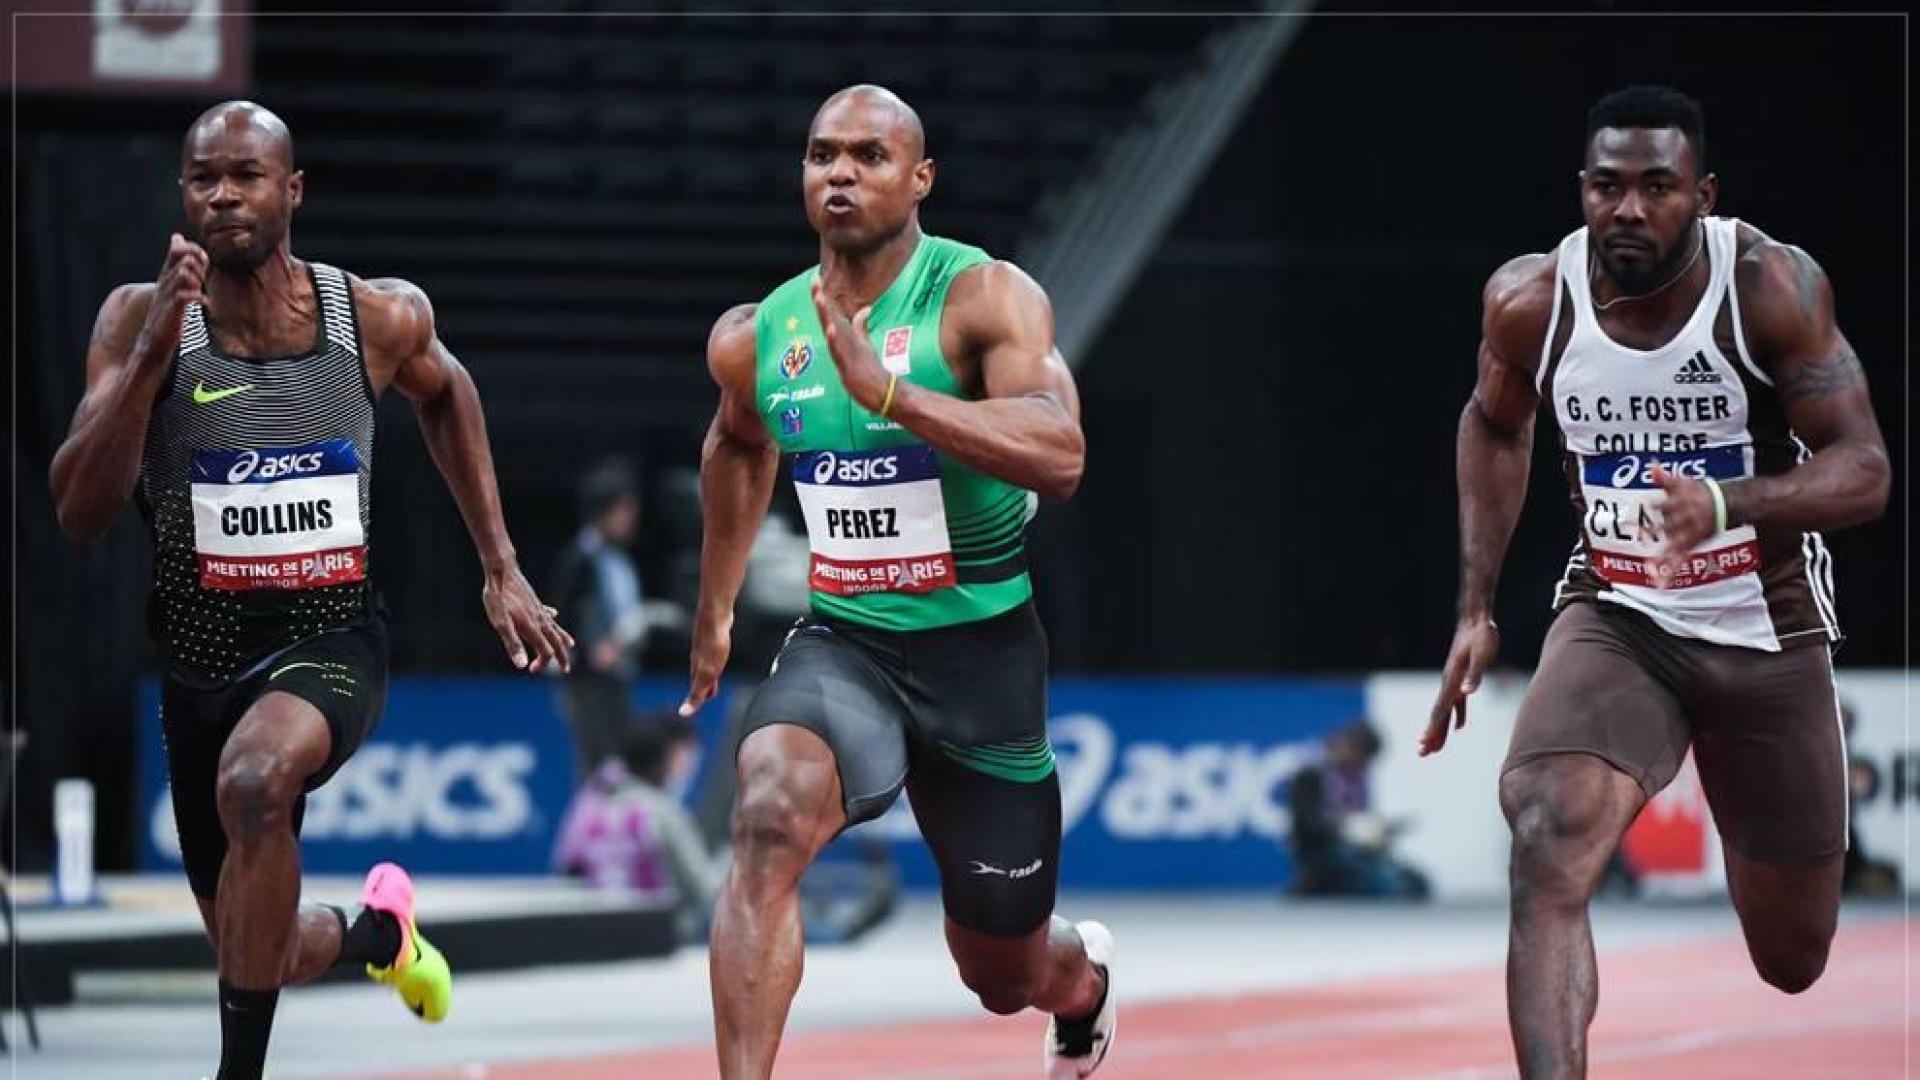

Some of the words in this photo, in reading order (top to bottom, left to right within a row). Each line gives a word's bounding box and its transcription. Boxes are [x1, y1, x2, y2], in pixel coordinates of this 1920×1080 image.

[1674, 373, 1722, 385] adidas
[1566, 395, 1590, 422] G.
[1597, 396, 1622, 422] C.
[1629, 394, 1731, 422] FOSTER
[1595, 432, 1708, 452] COLLEGE
[221, 498, 333, 536] COLLINS
[826, 507, 901, 539] PEREZ
[1590, 498, 1661, 543] CLA
[206, 559, 280, 577] MEETING
[302, 552, 355, 580] PARIS
[888, 559, 947, 586] PARIS
[1693, 547, 1752, 577] PARIS
